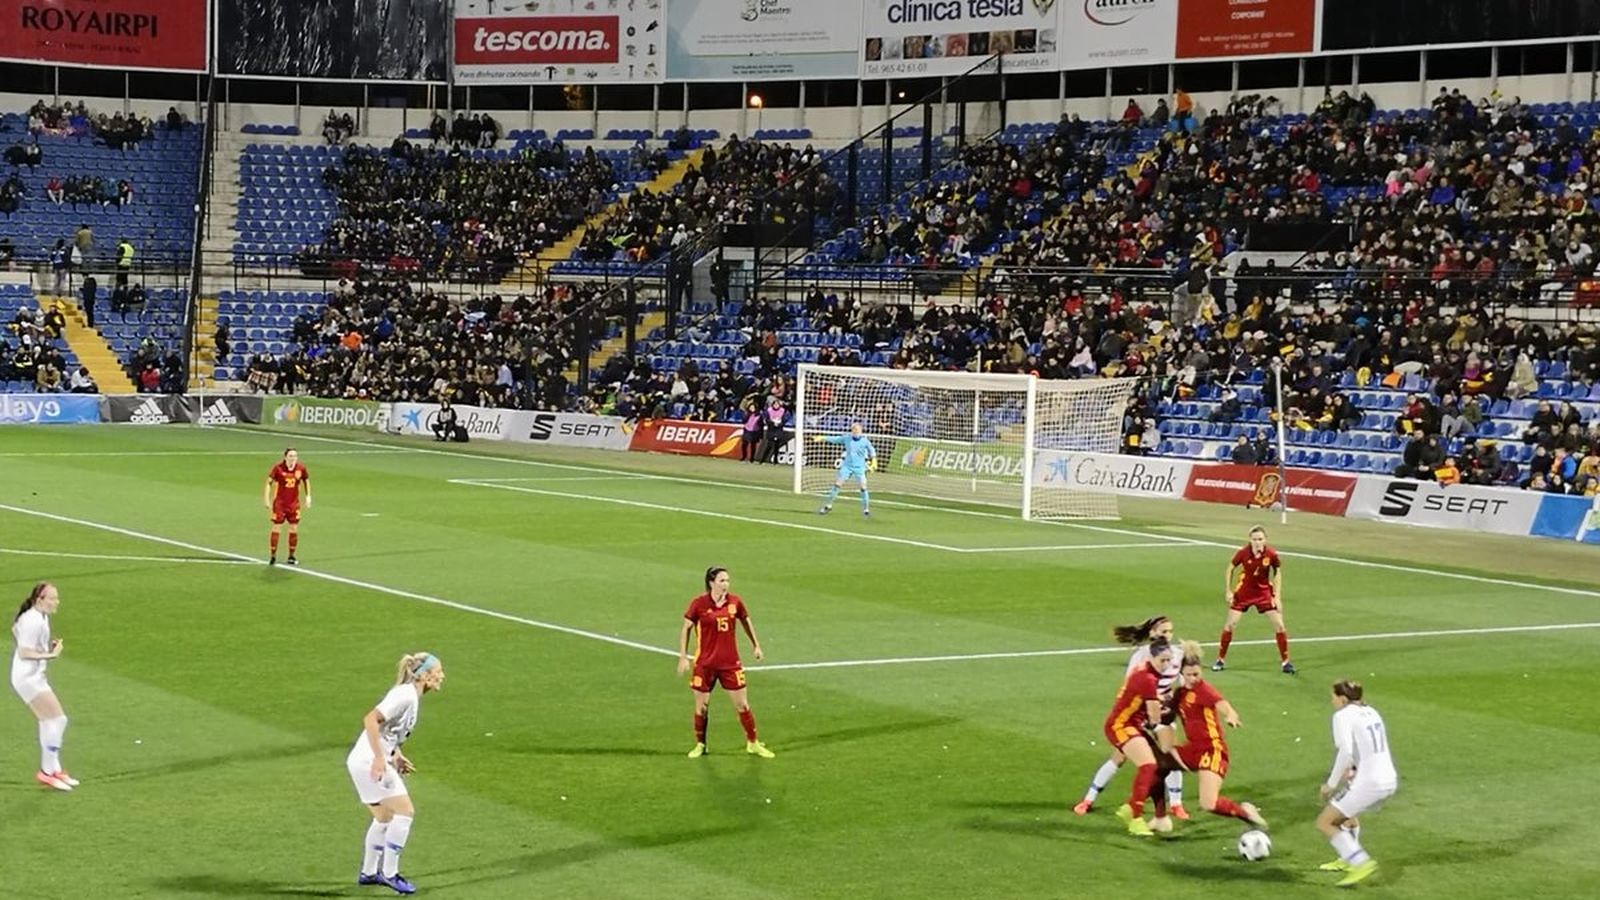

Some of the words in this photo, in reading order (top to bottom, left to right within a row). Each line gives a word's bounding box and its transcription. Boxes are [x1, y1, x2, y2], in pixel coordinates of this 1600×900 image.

[967, 0, 1023, 18] tesla
[22, 6, 157, 38] ROYAIRPI
[473, 27, 610, 51] tescoma.
[881, 64, 895, 73] 965
[896, 63, 906, 72] 42
[907, 63, 915, 72] 61
[559, 423, 615, 437] SEAT
[656, 426, 716, 445] IBERIA
[926, 449, 1025, 477] IBERDROLA
[1075, 457, 1176, 493] CaixaBank
[1424, 494, 1508, 515] SEAT
[716, 617, 729, 632] 15
[1366, 722, 1385, 754] 17
